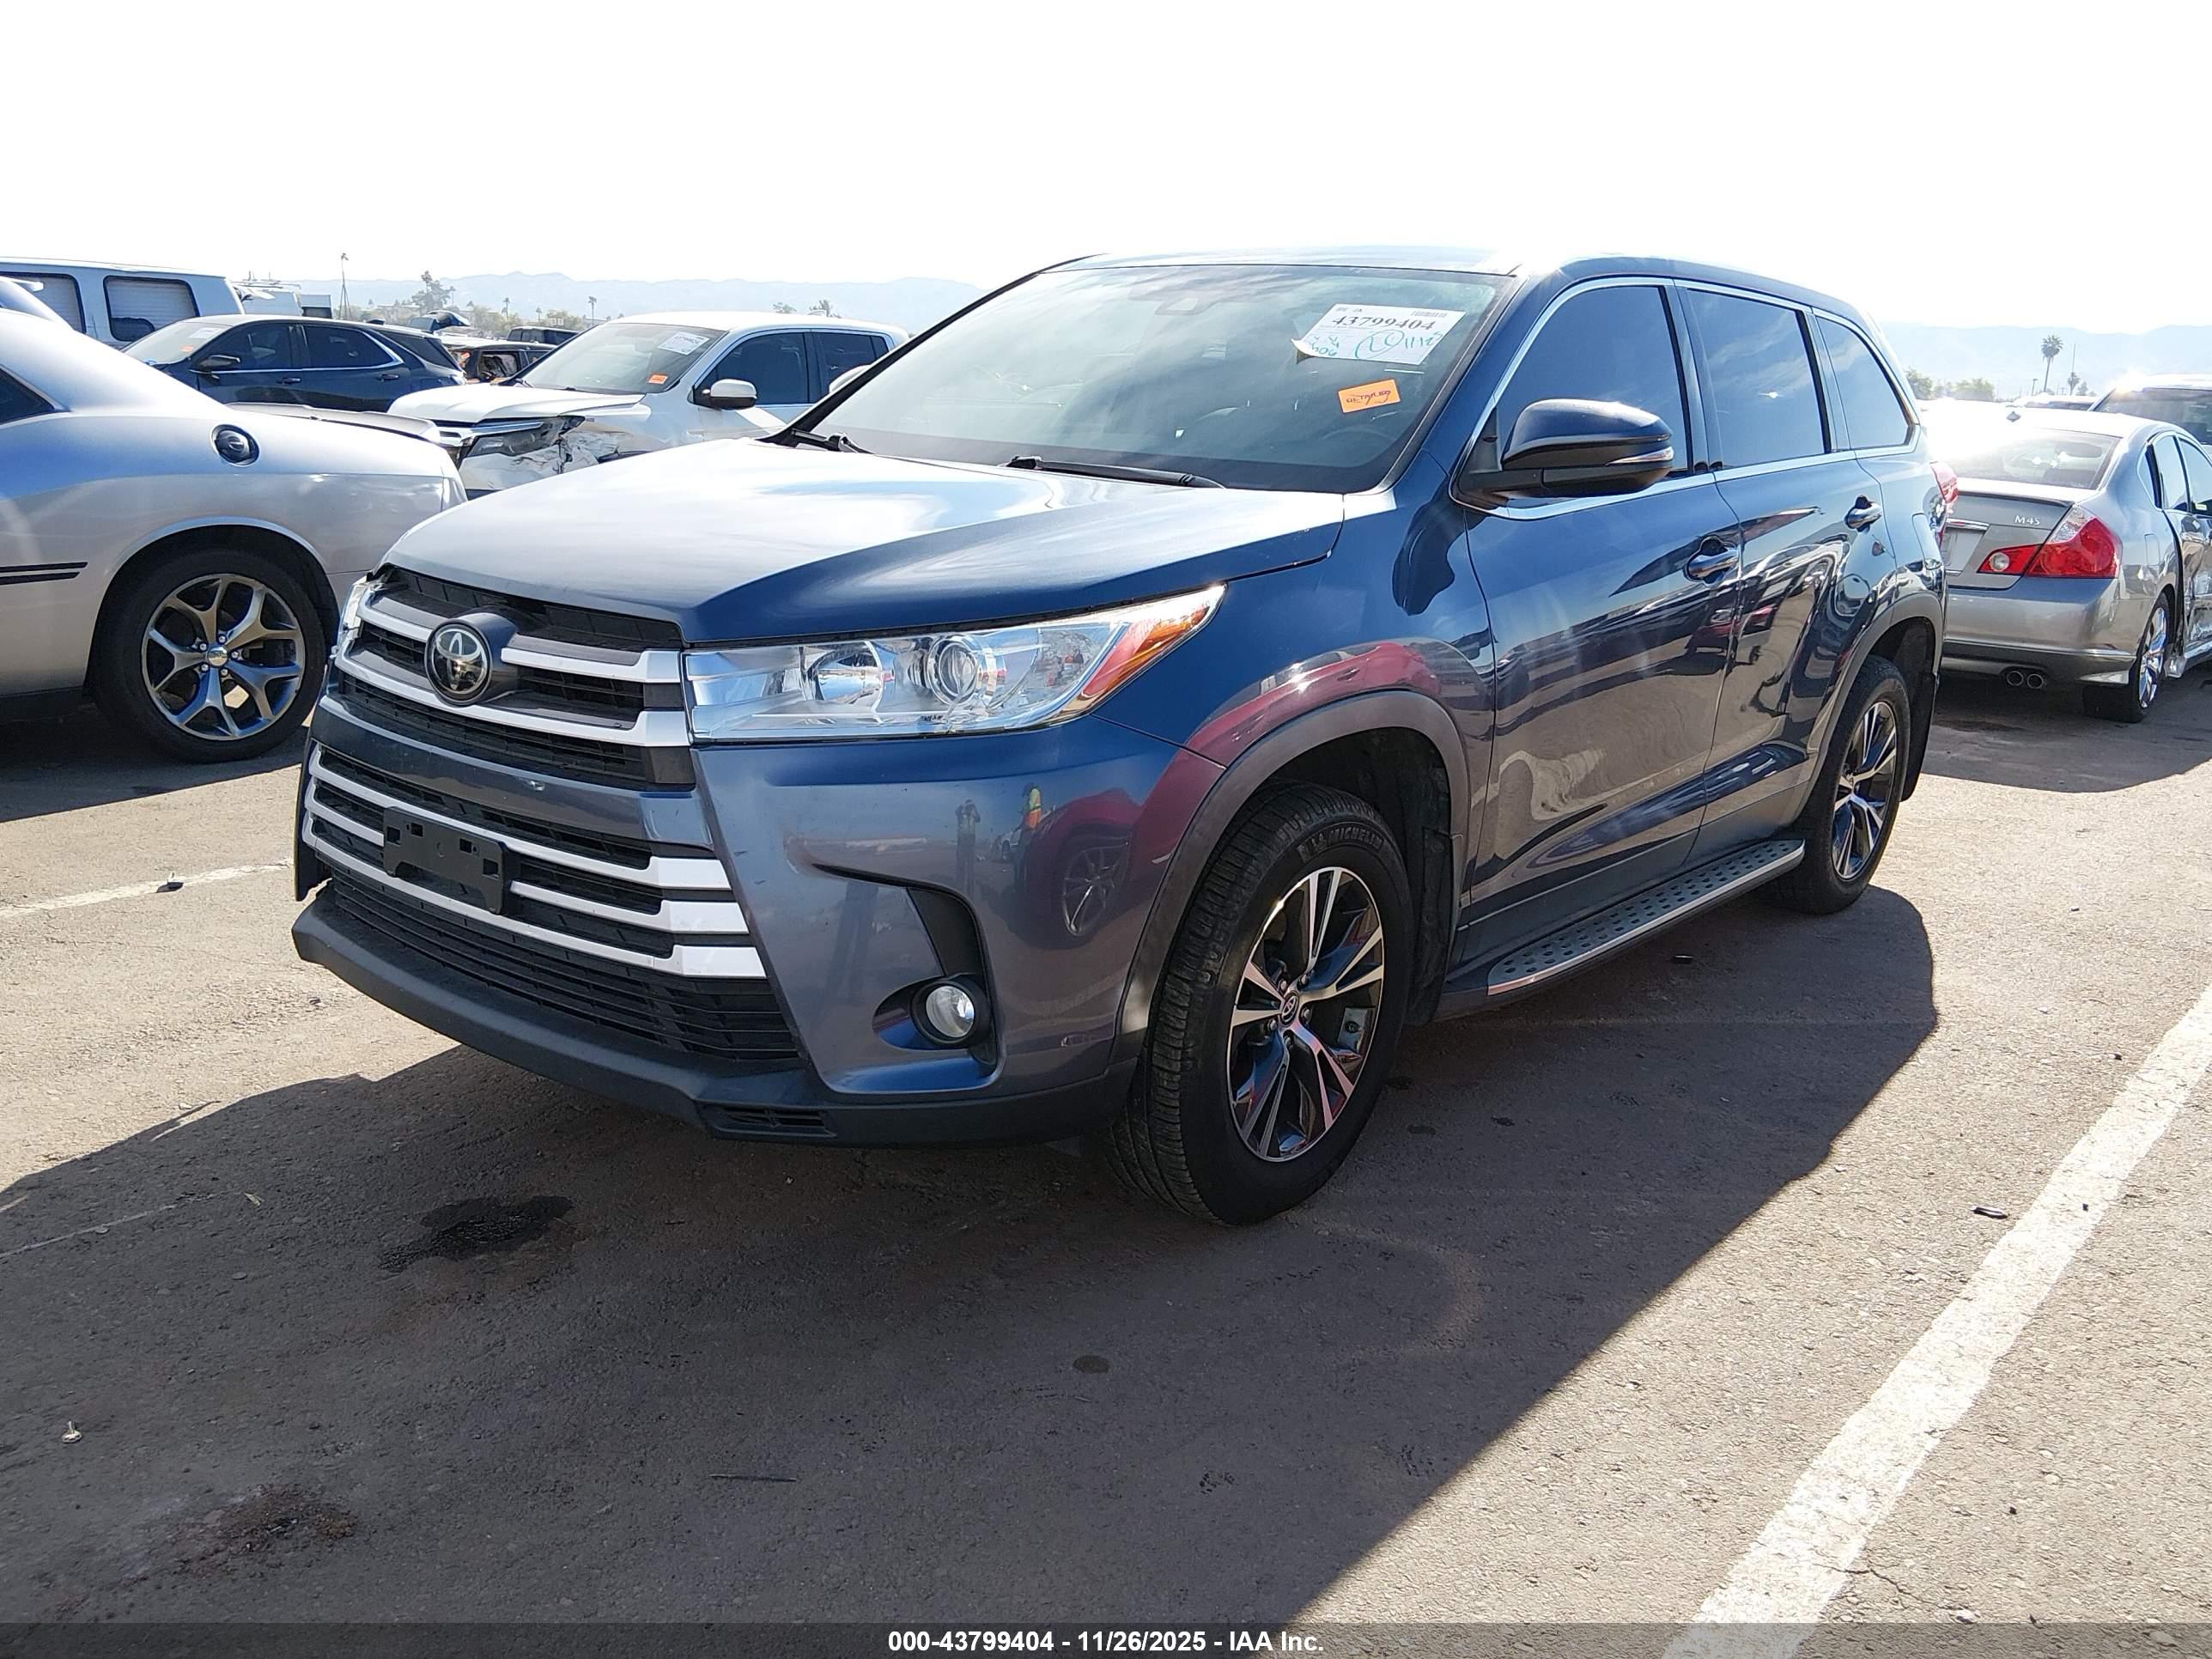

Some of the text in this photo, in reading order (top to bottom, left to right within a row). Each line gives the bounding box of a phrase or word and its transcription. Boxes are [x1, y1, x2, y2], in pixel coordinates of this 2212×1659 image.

[1332, 315, 1436, 331] 43799404
[2014, 514, 2040, 526] M45
[1329, 826, 1384, 850] MICHELIN
